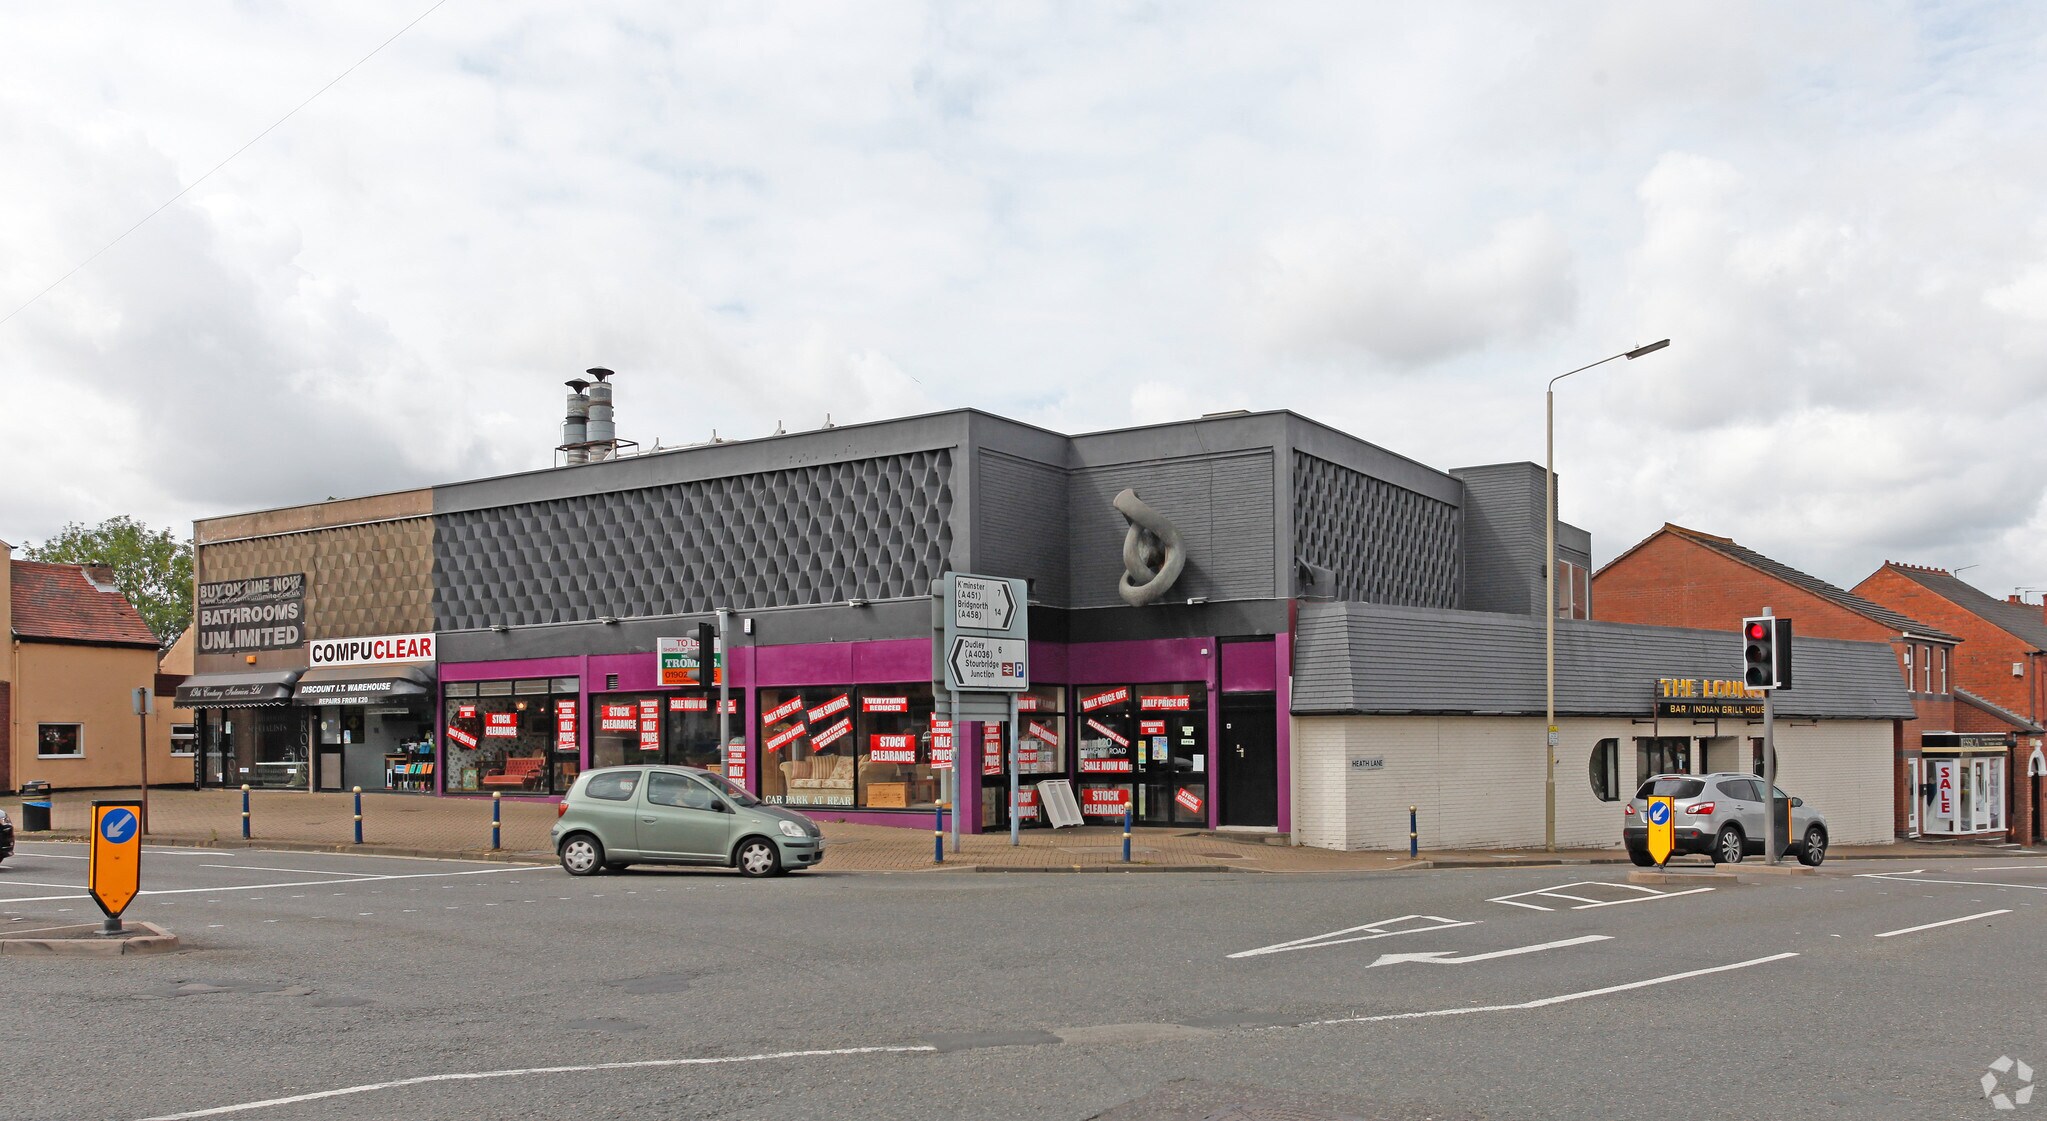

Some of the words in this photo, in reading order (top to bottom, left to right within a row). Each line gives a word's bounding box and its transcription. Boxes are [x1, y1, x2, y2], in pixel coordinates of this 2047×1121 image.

[200, 585, 222, 598] BUY
[225, 583, 241, 597] ON
[245, 579, 270, 594] LINE
[273, 575, 300, 591] NOW
[957, 580, 985, 590] K'minster
[957, 591, 982, 600] (A451)
[957, 600, 988, 611] Bridgnorth
[201, 602, 298, 626] BATHROOMS
[957, 610, 982, 620] (A458)
[994, 608, 1002, 616] 14
[201, 625, 299, 650] UNLIMITED
[676, 639, 687, 647] TO
[312, 637, 432, 663] COMPUCLEAR
[964, 640, 985, 649] Dudley
[998, 646, 1002, 654] 6
[965, 659, 1000, 669] Stourbridge
[665, 671, 688, 679] 01902
[970, 669, 995, 678] Junction
[203, 686, 223, 700] Century
[250, 683, 263, 695] Ltd
[301, 684, 335, 694] DISCOUNT
[336, 684, 346, 693] I.T.
[347, 682, 391, 692] WAREHOUSE
[1660, 678, 1698, 698] THE
[318, 697, 341, 705] REPAIRS
[358, 696, 368, 704] £20
[670, 699, 683, 709] SALE
[684, 699, 698, 709] NOW
[698, 699, 707, 709] ON
[1082, 697, 1098, 709] HALF
[1097, 692, 1116, 705] PRICE
[1115, 689, 1127, 699] OFF
[1142, 698, 1158, 708] HALF
[1158, 698, 1177, 708] PRICE
[1177, 698, 1189, 707] OFF
[609, 706, 630, 717] STOCK
[763, 710, 777, 724] HALF
[776, 705, 793, 718] PRICE
[791, 698, 802, 710] OFF
[808, 709, 825, 721] HUGE
[823, 696, 849, 714] SAVINGS
[1670, 704, 1686, 713] BAR
[1693, 705, 1720, 714] INDIAN
[1721, 705, 1744, 714] GRILL
[1745, 706, 1765, 714] HOUS
[492, 714, 510, 724] STOCK
[602, 719, 637, 730] CLEARANCE
[485, 726, 517, 736] CLEARANCE
[561, 721, 573, 731] HALF
[643, 721, 656, 731] HALF
[811, 717, 849, 745] EVERYTHING
[560, 732, 575, 742] PRICE
[641, 732, 658, 743] PRICE
[818, 727, 847, 748] REDUCED
[1087, 718, 1117, 740] CLEARANCE
[1115, 735, 1130, 747] SALE
[880, 736, 906, 748] STOCK
[934, 736, 951, 748] HALF
[986, 742, 998, 753] HALF
[871, 750, 915, 762] CLEARANCE
[1109, 747, 1127, 755] ROAD
[985, 755, 1000, 766] PRICE
[1084, 760, 1101, 771] SALE
[1101, 760, 1118, 771] NOW
[1119, 760, 1129, 771] ON
[1370, 759, 1383, 767] LANE
[729, 766, 744, 777] HALF
[1092, 790, 1119, 801] STOCK
[1940, 766, 1952, 814] SALE
[765, 795, 783, 804] CAR
[785, 795, 809, 804] PARK
[812, 795, 823, 805] AT
[827, 796, 851, 806] REAR
[1177, 795, 1199, 811] CLEARANCE
[1181, 790, 1199, 805] STOCK
[1083, 804, 1126, 815] CLEARANC
